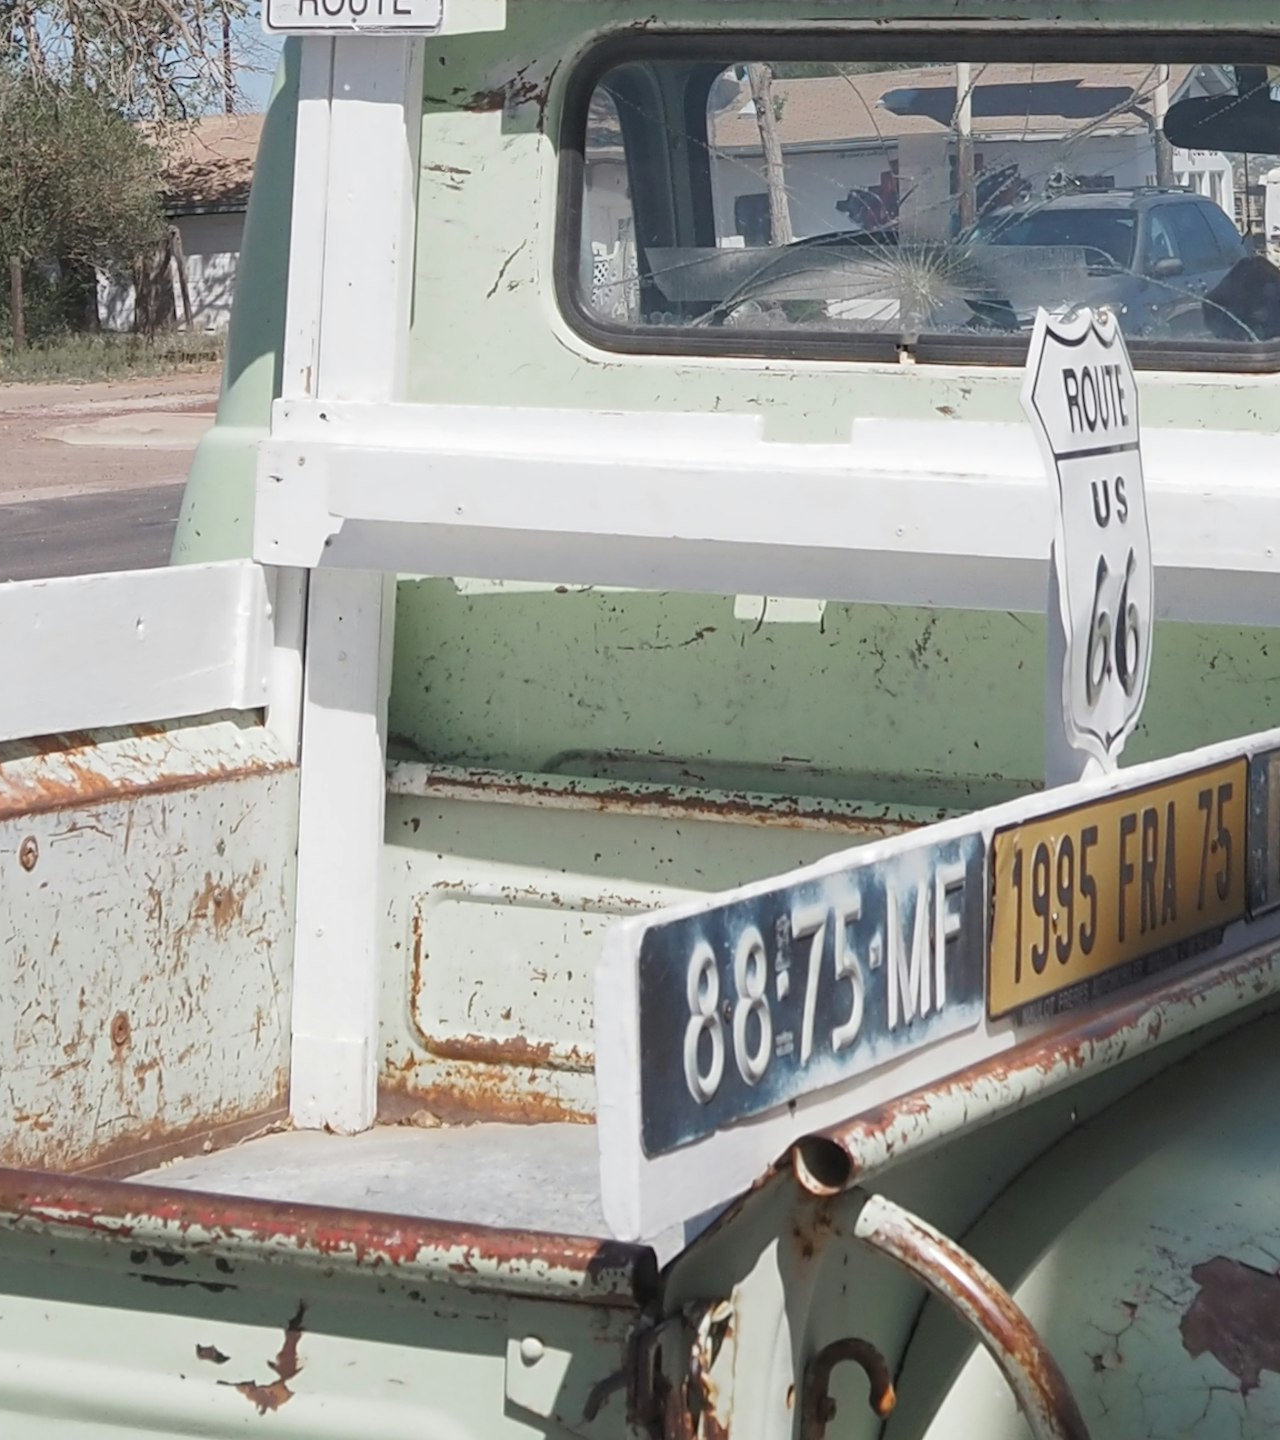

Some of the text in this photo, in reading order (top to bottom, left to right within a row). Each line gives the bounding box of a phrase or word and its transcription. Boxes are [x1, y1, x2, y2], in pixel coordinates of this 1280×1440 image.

[1061, 363, 1129, 434] ROUTE
[1085, 546, 1139, 707] 66
[1012, 825, 1099, 984] 1995
[1119, 801, 1177, 943] FRA
[1198, 782, 1233, 911] 75
